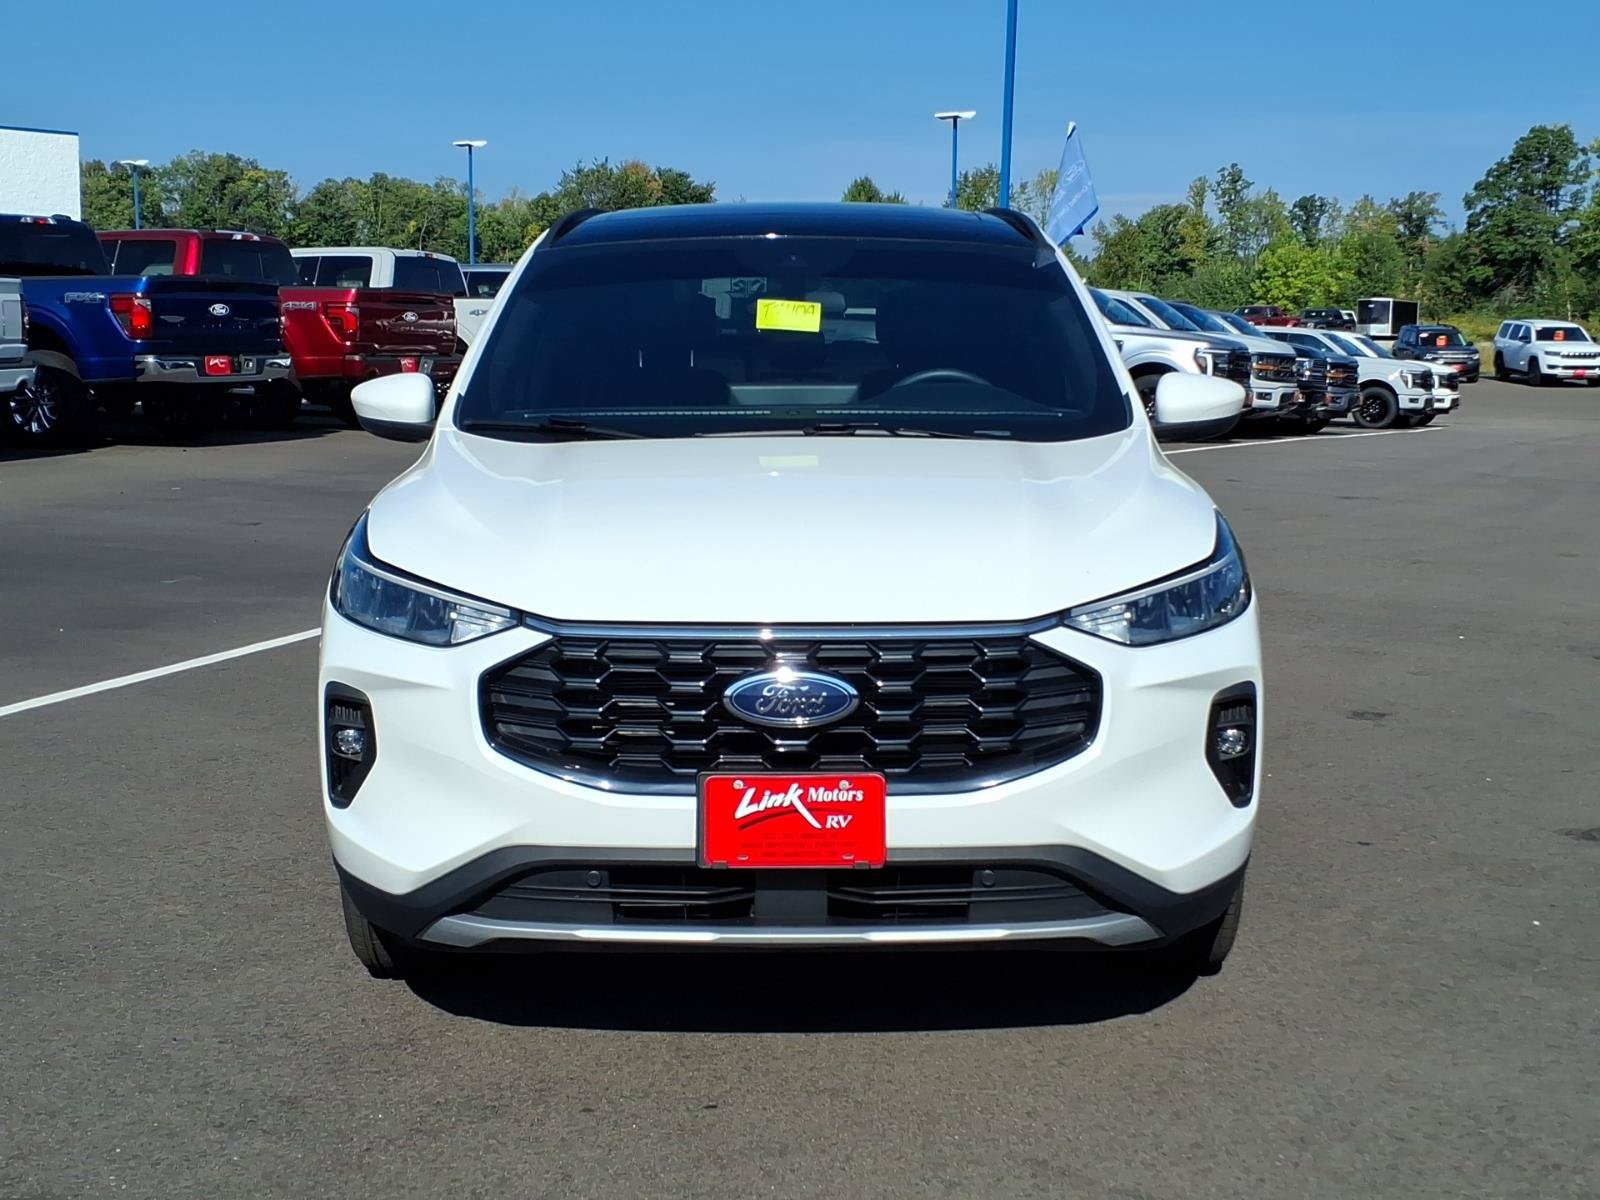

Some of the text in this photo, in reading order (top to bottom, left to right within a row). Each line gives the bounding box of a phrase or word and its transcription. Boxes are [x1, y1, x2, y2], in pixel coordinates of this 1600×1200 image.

[755, 682, 826, 714] Ford
[734, 783, 864, 829] Link Motors
[825, 814, 853, 829] RV
